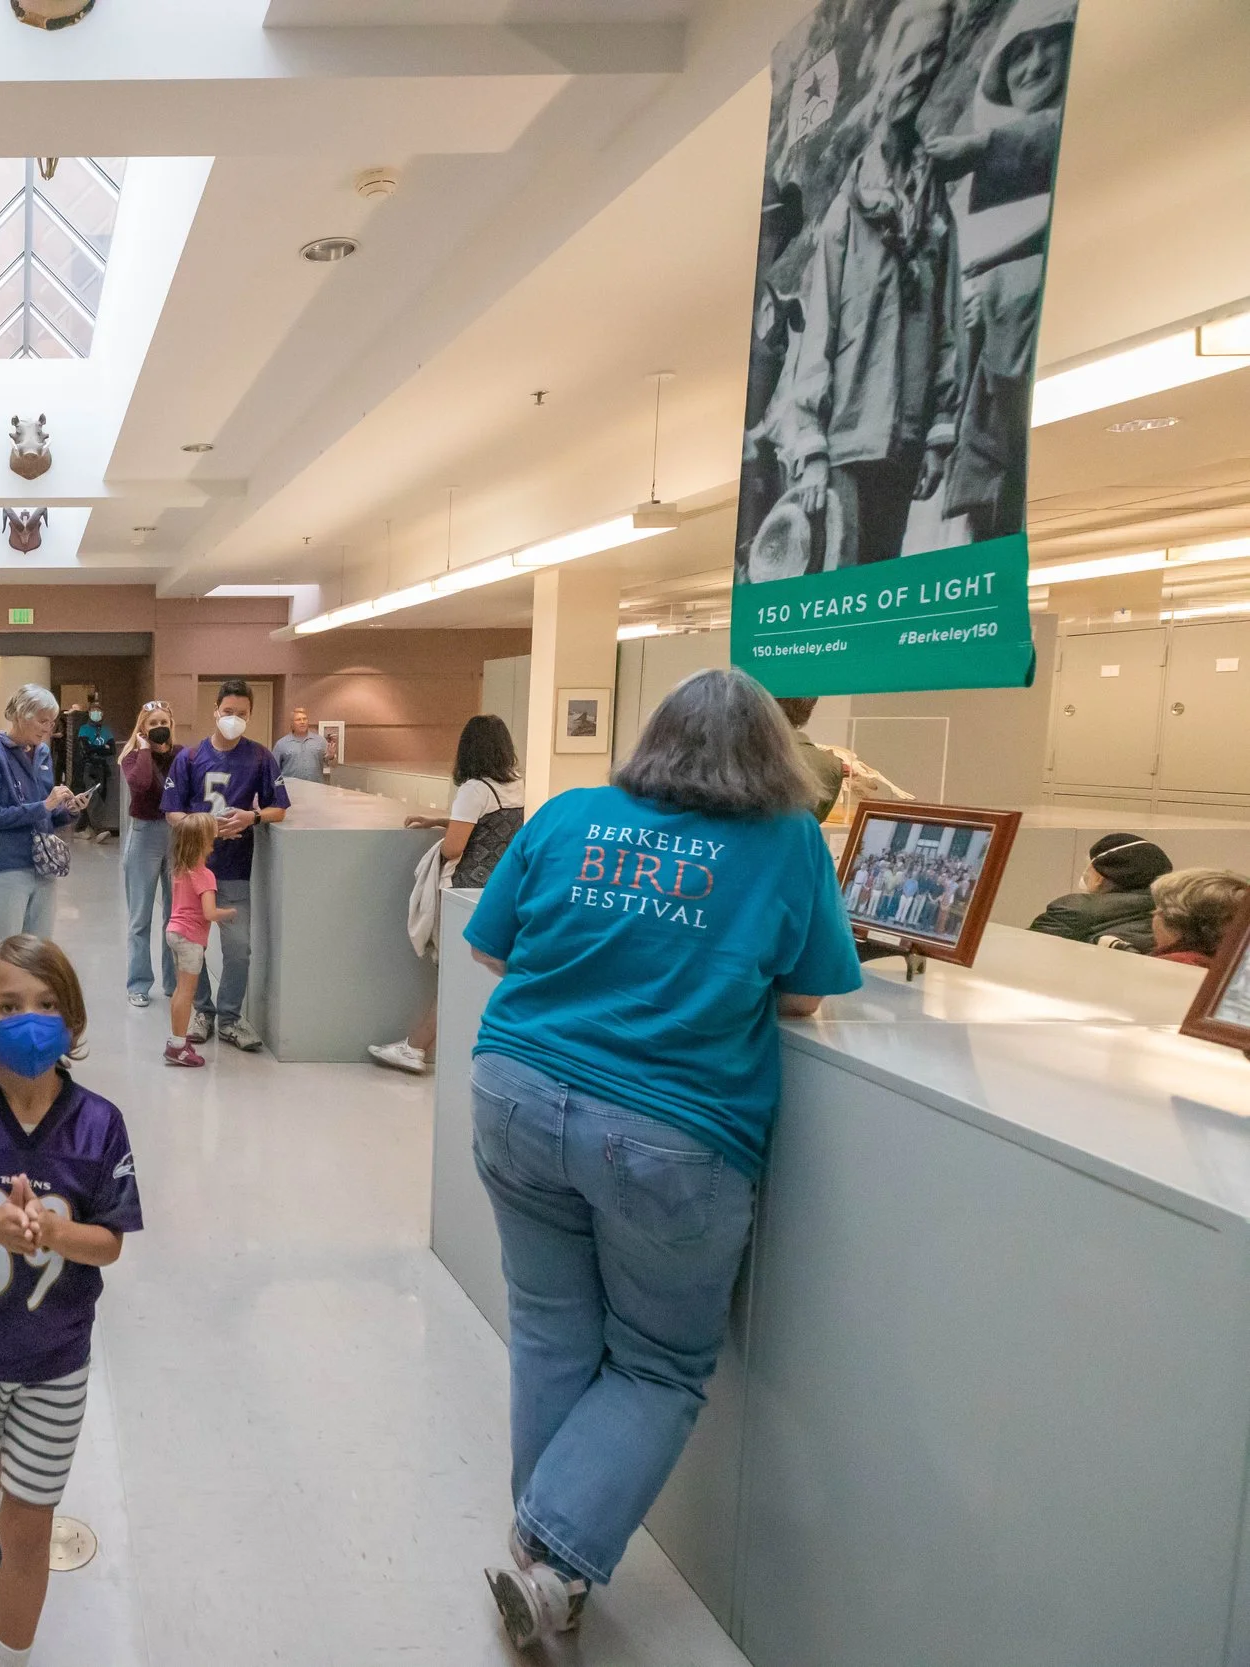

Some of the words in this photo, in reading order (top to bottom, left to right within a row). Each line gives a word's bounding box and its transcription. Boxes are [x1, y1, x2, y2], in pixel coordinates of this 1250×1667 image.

[757, 604, 791, 624] 150
[800, 593, 868, 619] YEARS
[877, 586, 909, 610] OF
[919, 572, 996, 605] LIGHT
[752, 639, 848, 657] 150.berkeley.edu
[898, 622, 999, 646] #Berkeley150
[203, 771, 232, 818] 5
[584, 823, 726, 861] BERKELEY
[574, 845, 714, 900] BIRD
[569, 886, 708, 929] FESTIVAL
